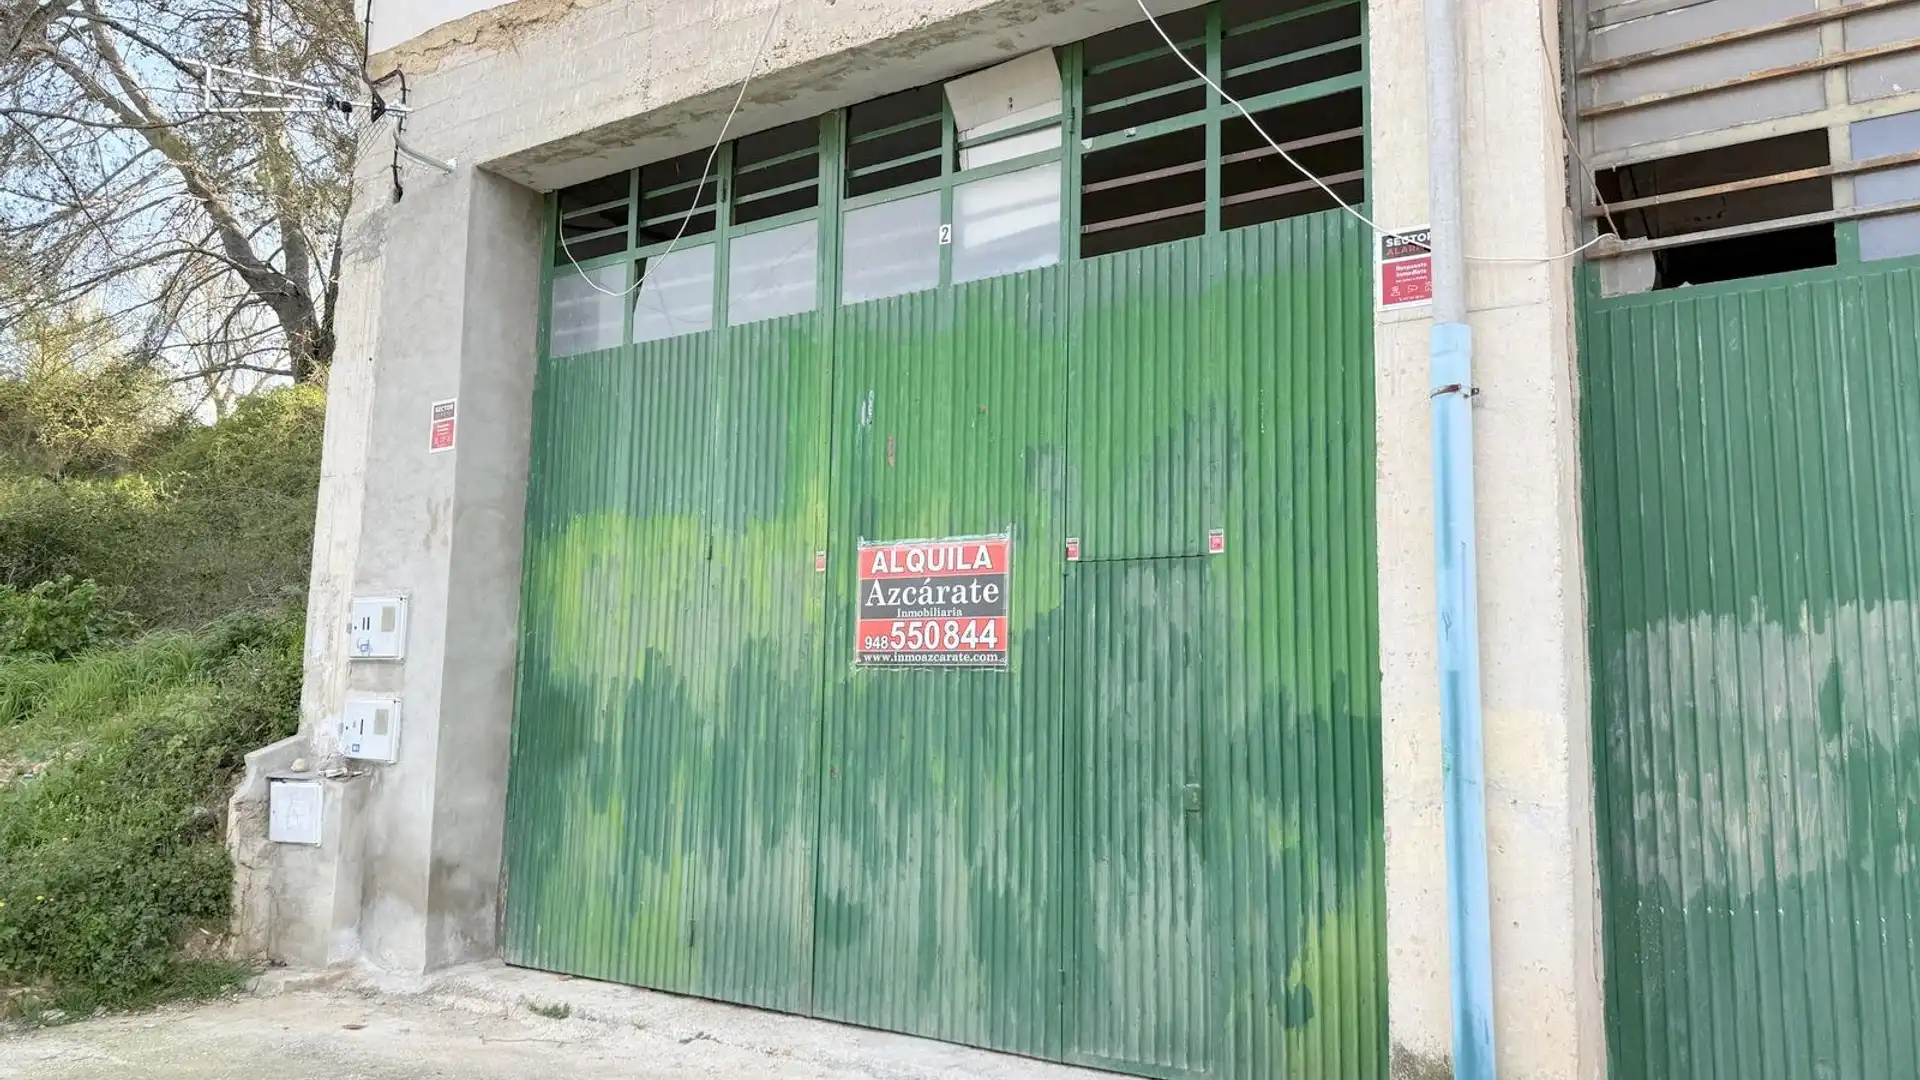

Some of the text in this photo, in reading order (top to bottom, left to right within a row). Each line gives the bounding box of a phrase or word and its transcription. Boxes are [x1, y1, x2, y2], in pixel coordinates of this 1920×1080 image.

[941, 226, 949, 243] 2
[871, 544, 993, 574] ALQUILA
[865, 577, 999, 606] Azcárate
[896, 607, 963, 618] Inmobiliaria
[864, 635, 889, 650] 948
[864, 651, 998, 664] www.inmoazcarate.com
